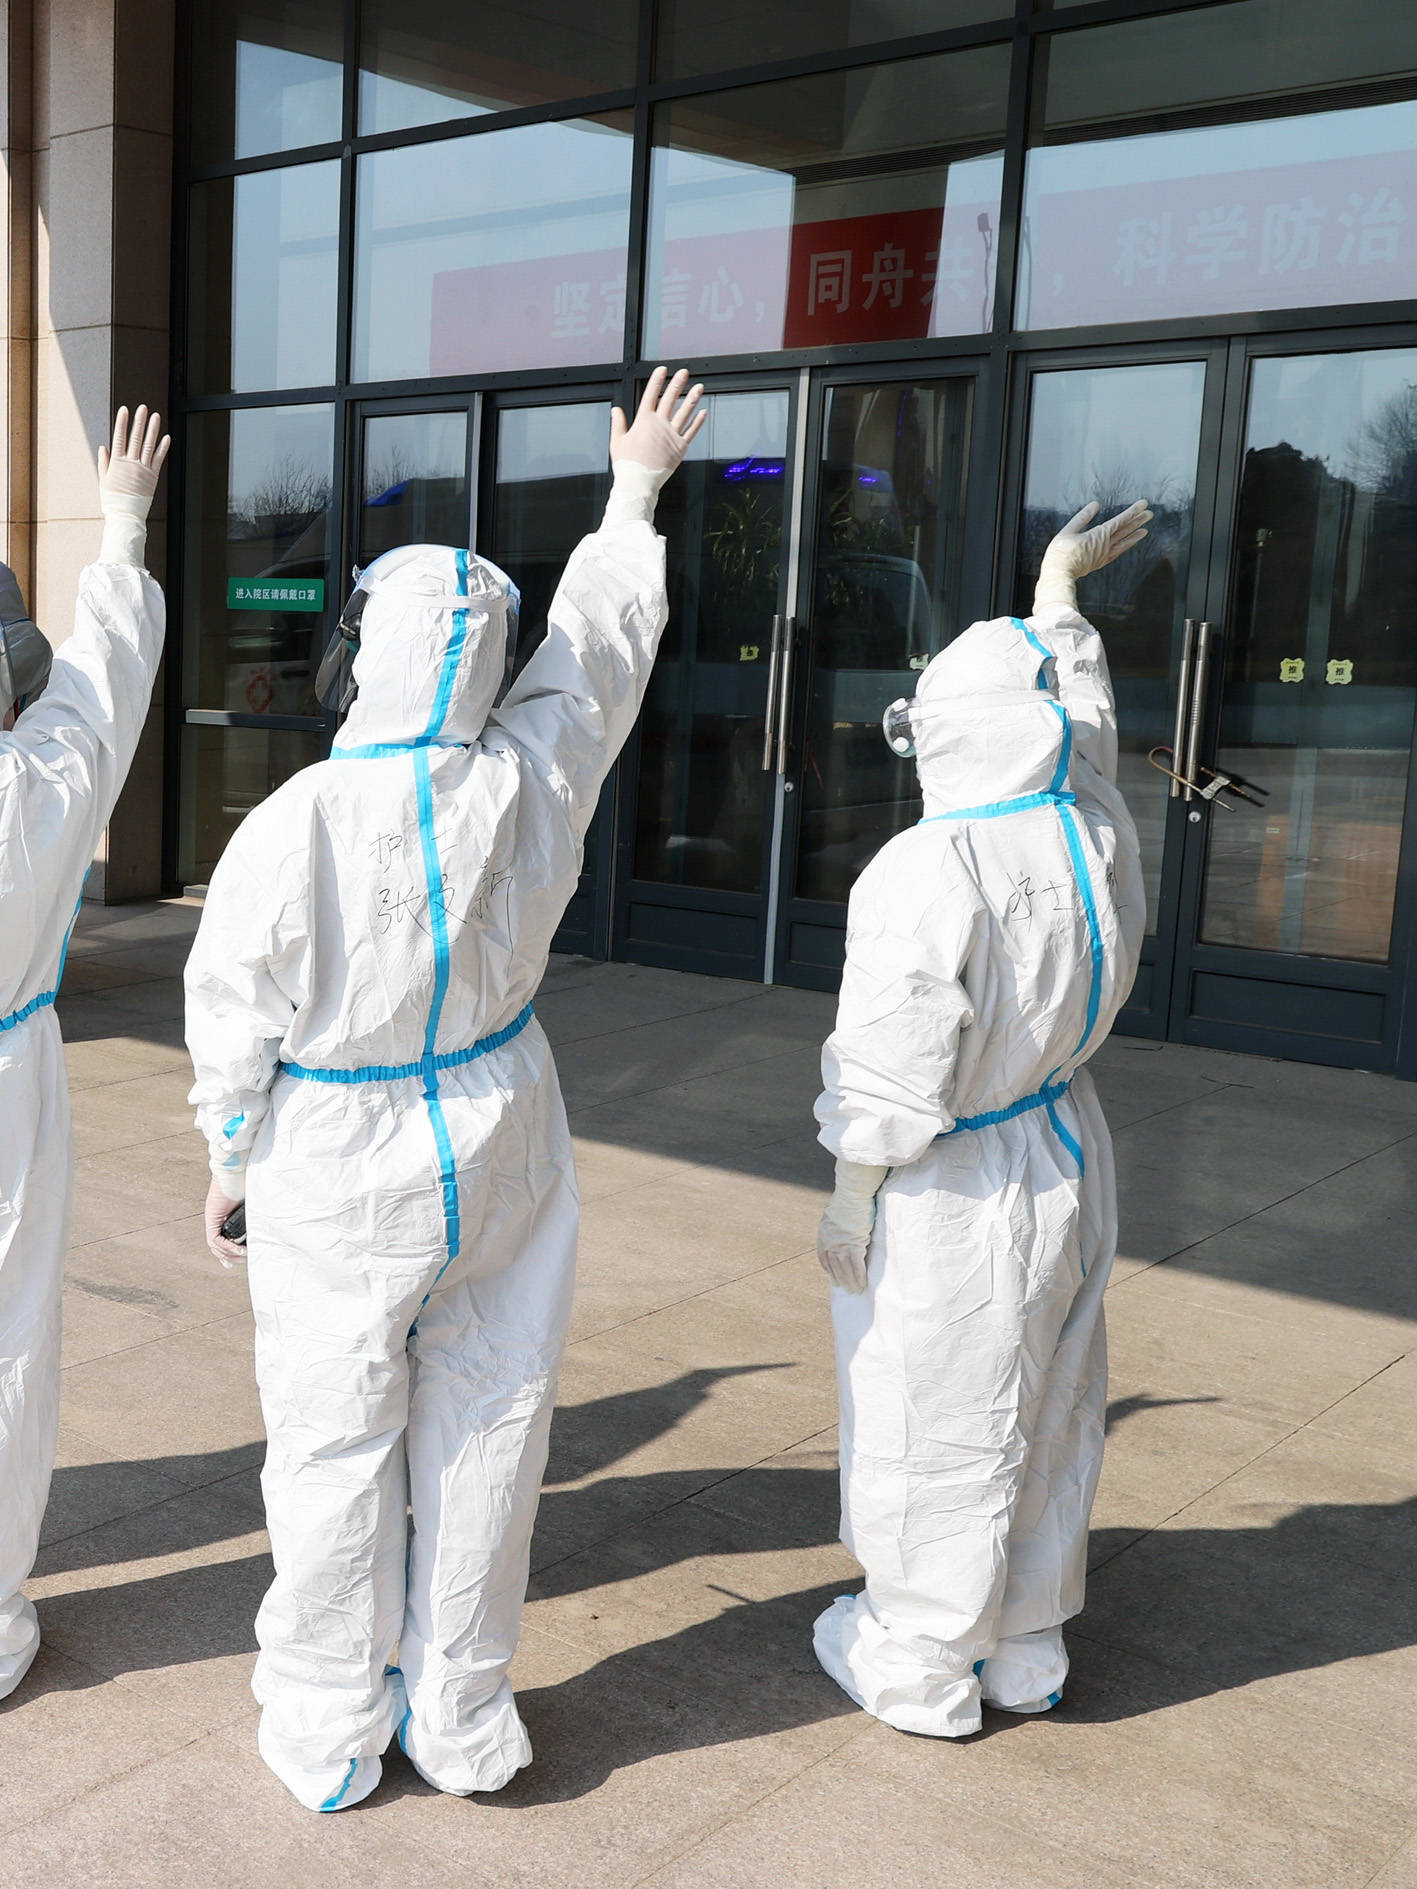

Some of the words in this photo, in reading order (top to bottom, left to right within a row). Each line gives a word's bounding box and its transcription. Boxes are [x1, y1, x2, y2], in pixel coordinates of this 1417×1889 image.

[235, 587, 316, 601] 进入院区请佩戴口罩
